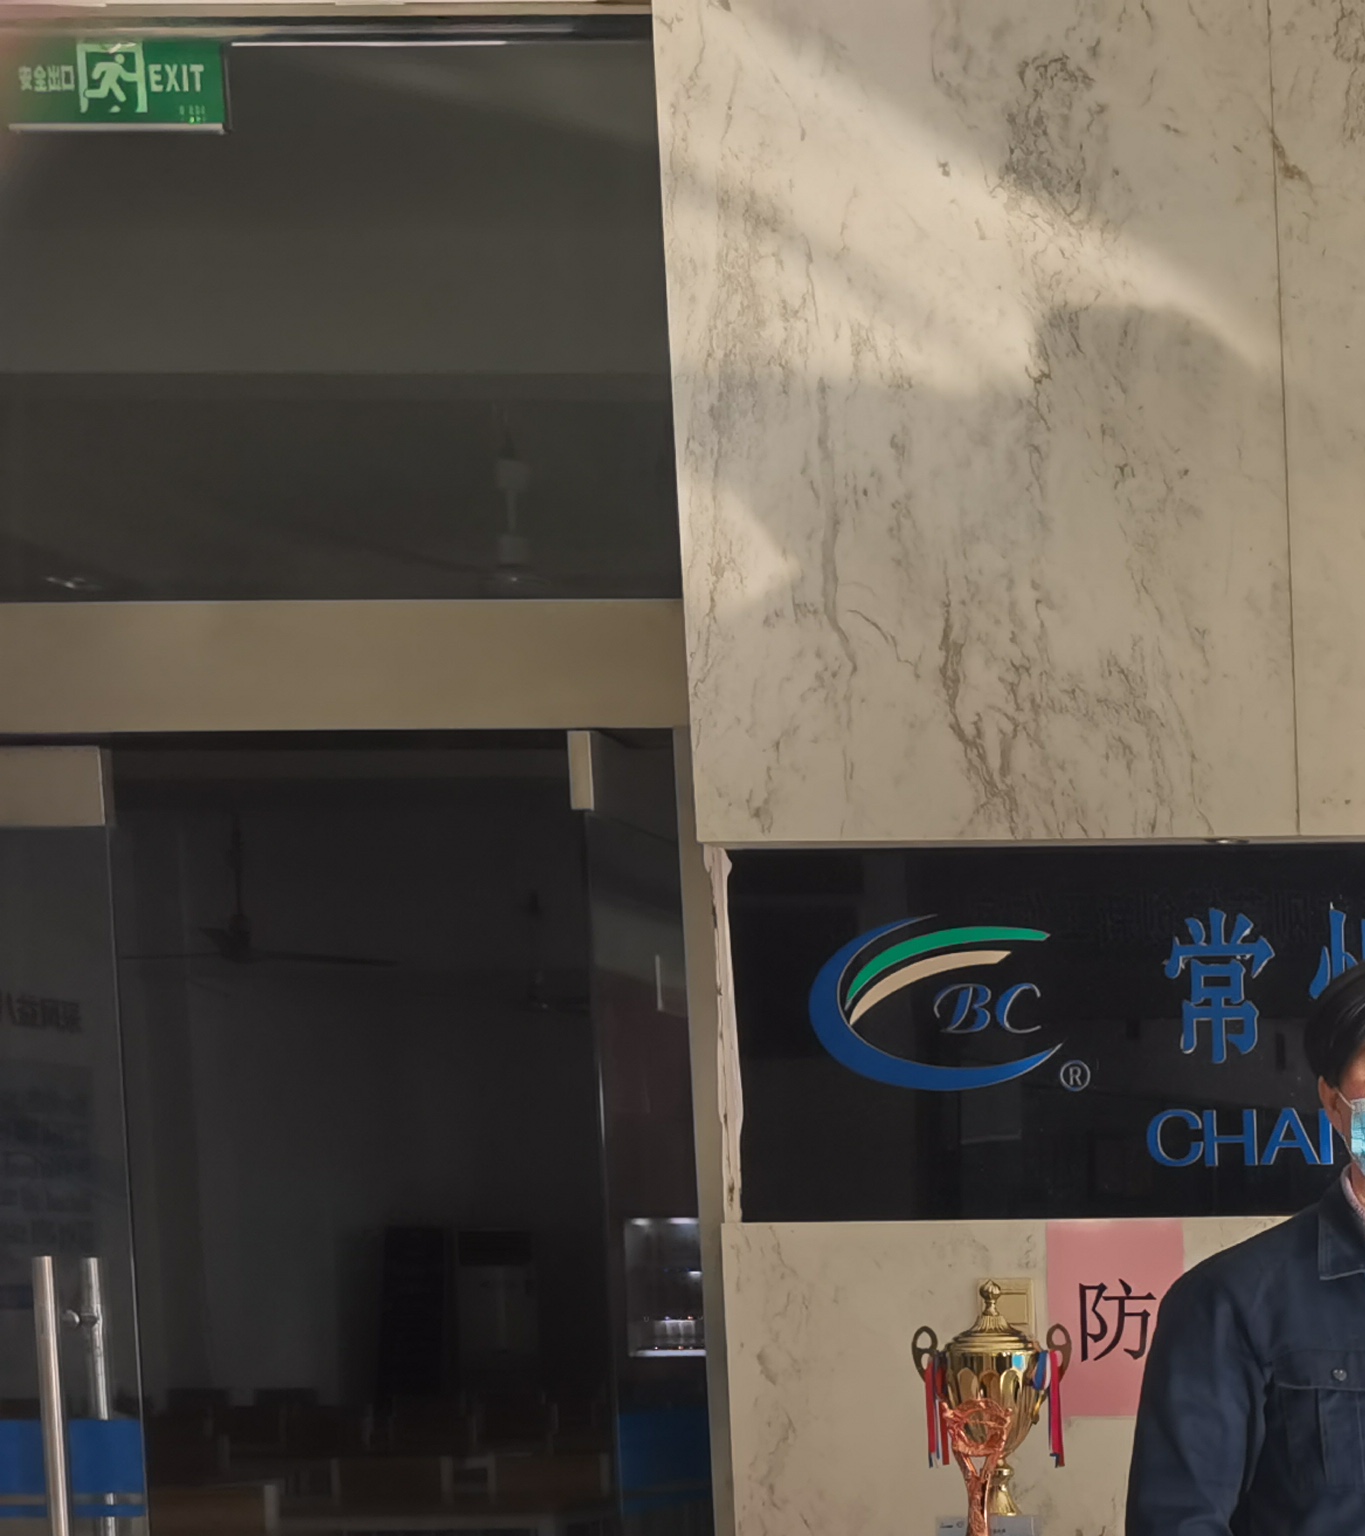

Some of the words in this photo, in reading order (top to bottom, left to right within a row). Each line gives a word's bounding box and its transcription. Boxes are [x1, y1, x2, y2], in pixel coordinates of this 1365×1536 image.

[18, 64, 75, 92] 安全出口
[149, 63, 205, 92] EXIT
[1078, 1278, 1157, 1362] 防
